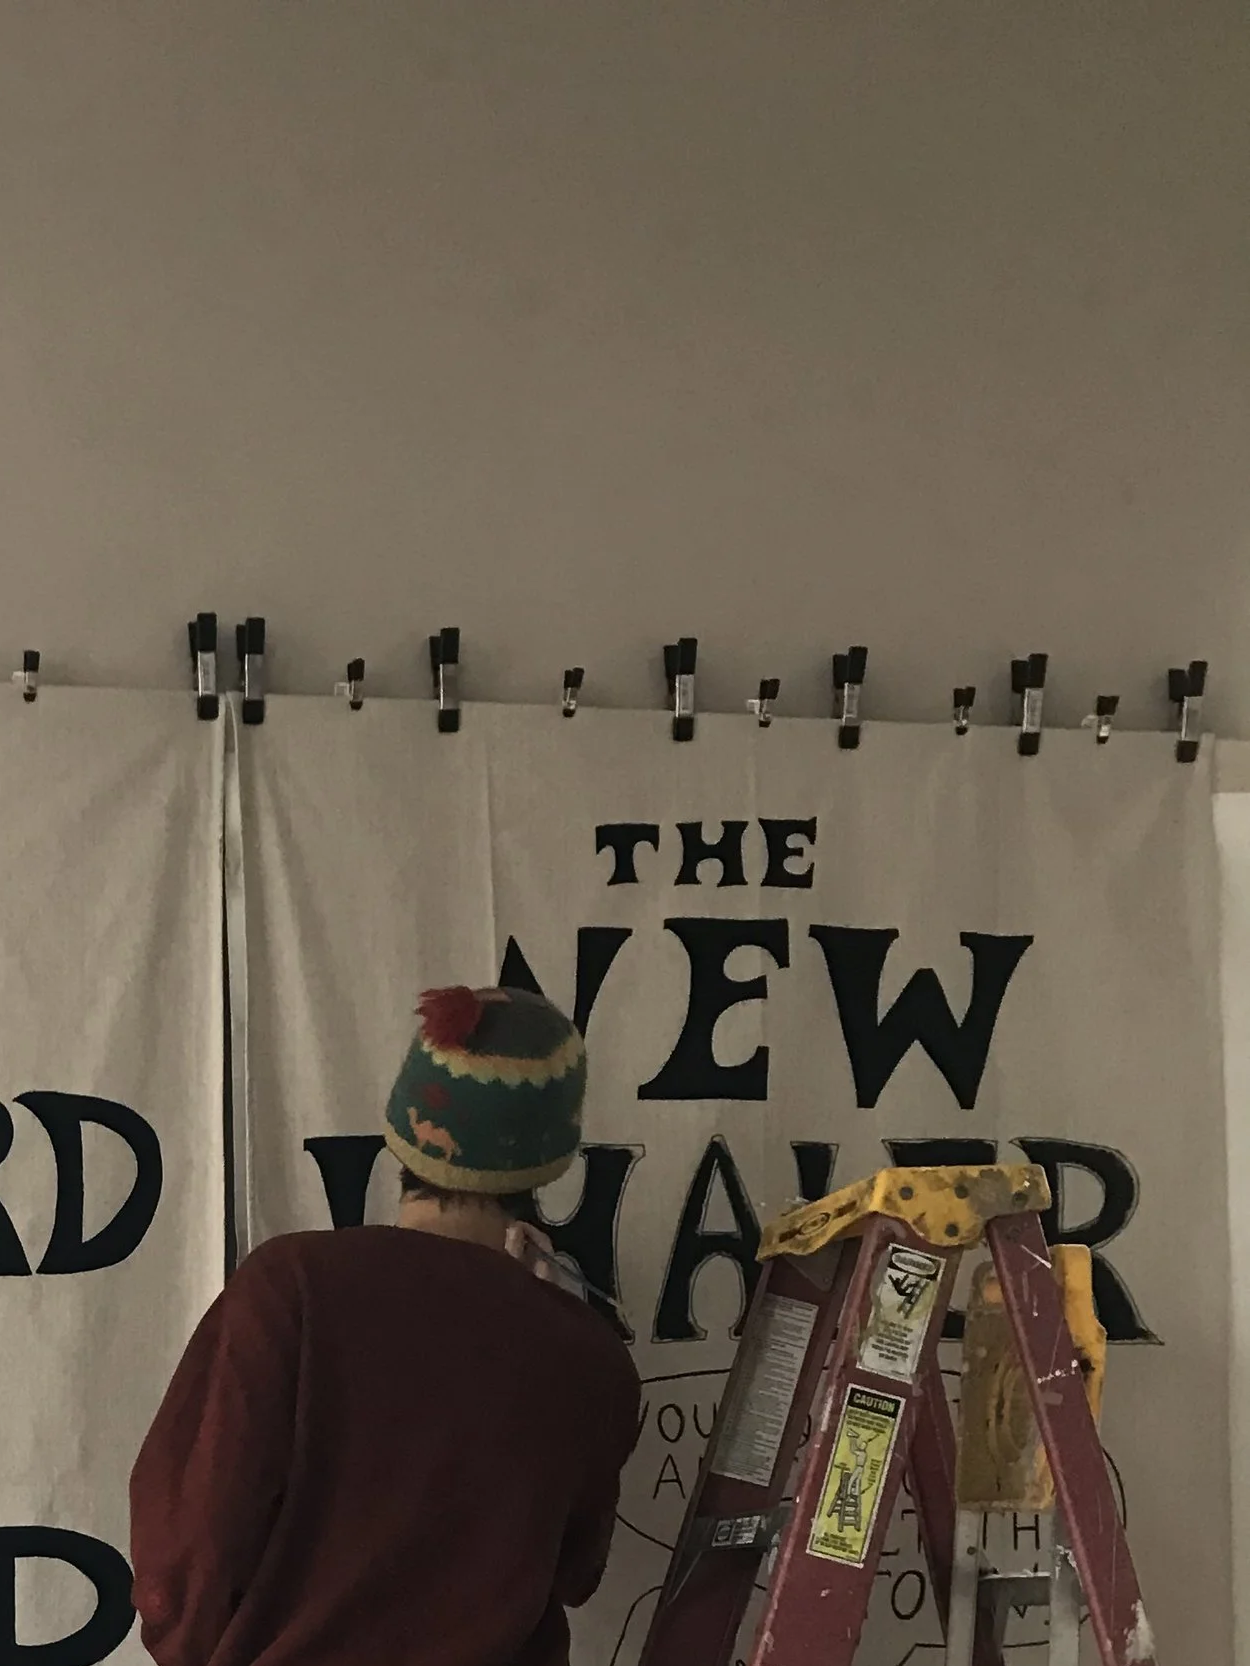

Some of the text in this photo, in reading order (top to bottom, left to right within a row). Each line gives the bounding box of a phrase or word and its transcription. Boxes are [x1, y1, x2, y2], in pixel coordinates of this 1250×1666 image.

[596, 817, 817, 888] THE
[303, 1135, 1164, 1345] HAR
[853, 1392, 896, 1413] CAUTION
